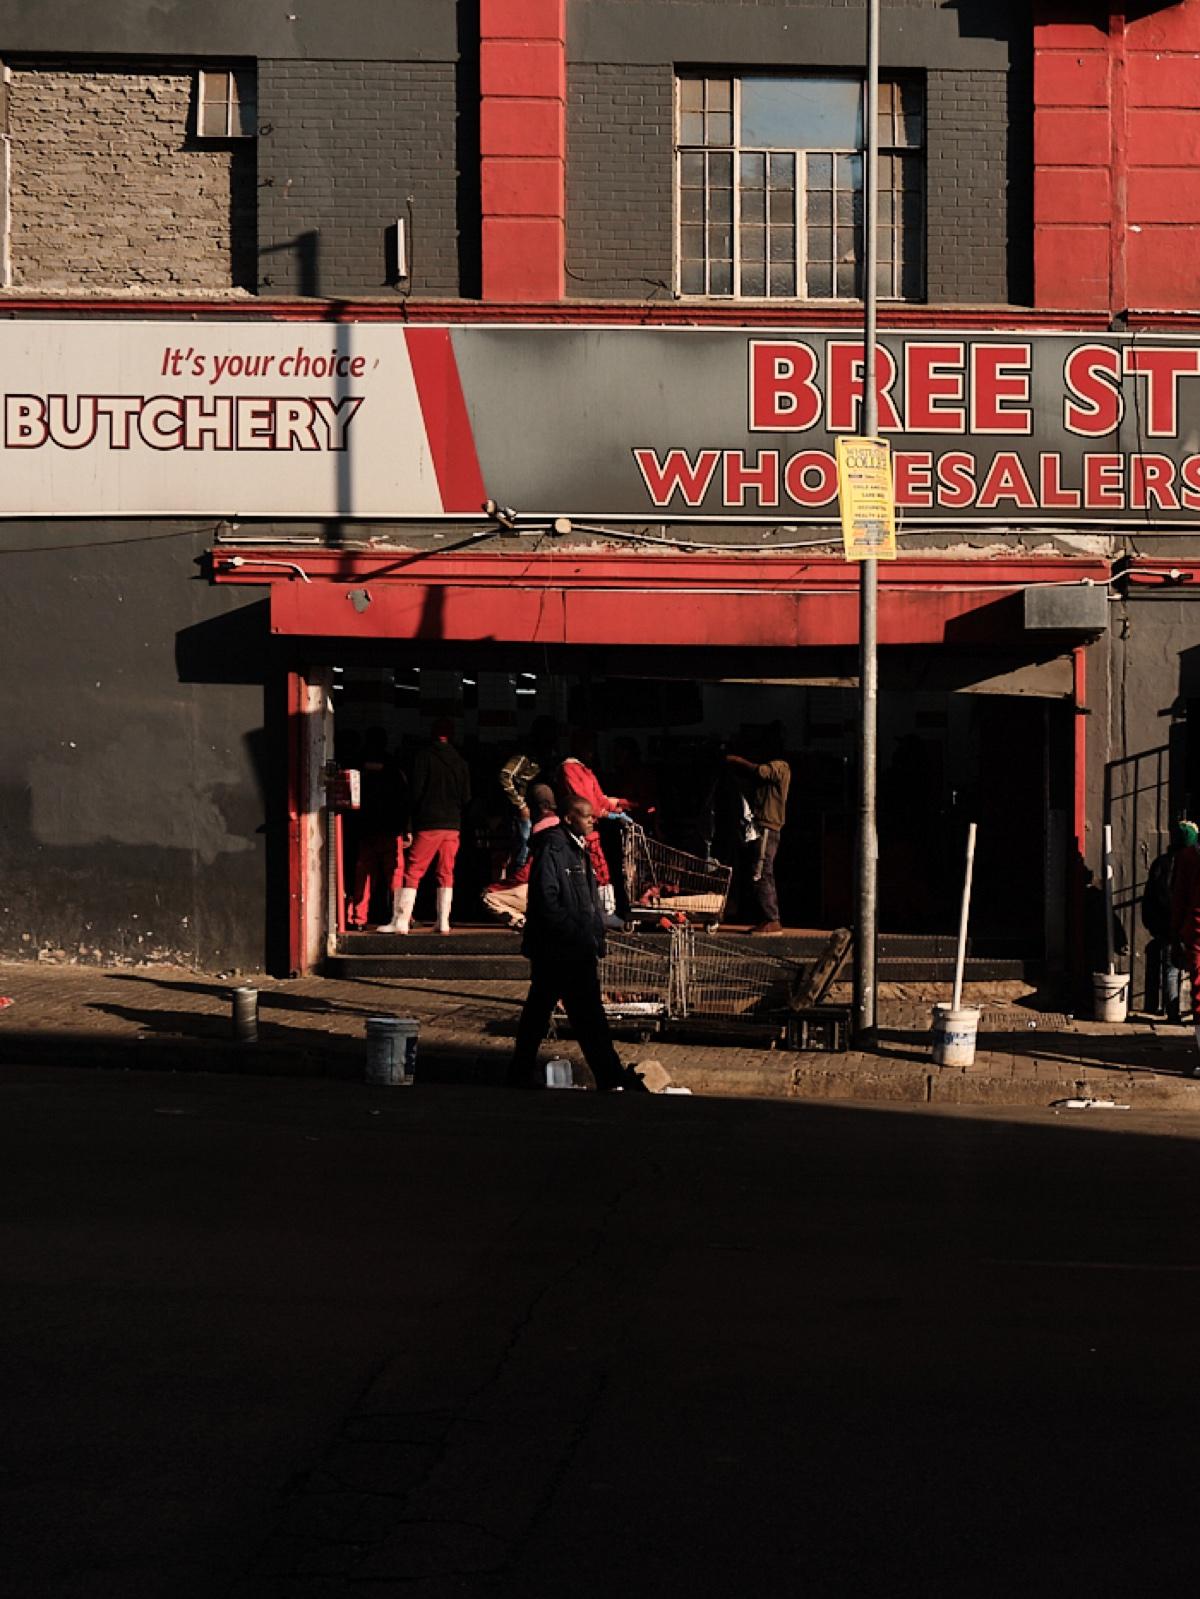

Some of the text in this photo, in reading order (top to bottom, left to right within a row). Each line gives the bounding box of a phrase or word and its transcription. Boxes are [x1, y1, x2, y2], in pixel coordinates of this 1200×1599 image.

[161, 346, 366, 385] It's your choice
[748, 339, 1033, 437] BREE
[3, 394, 366, 451] BUTCHERY
